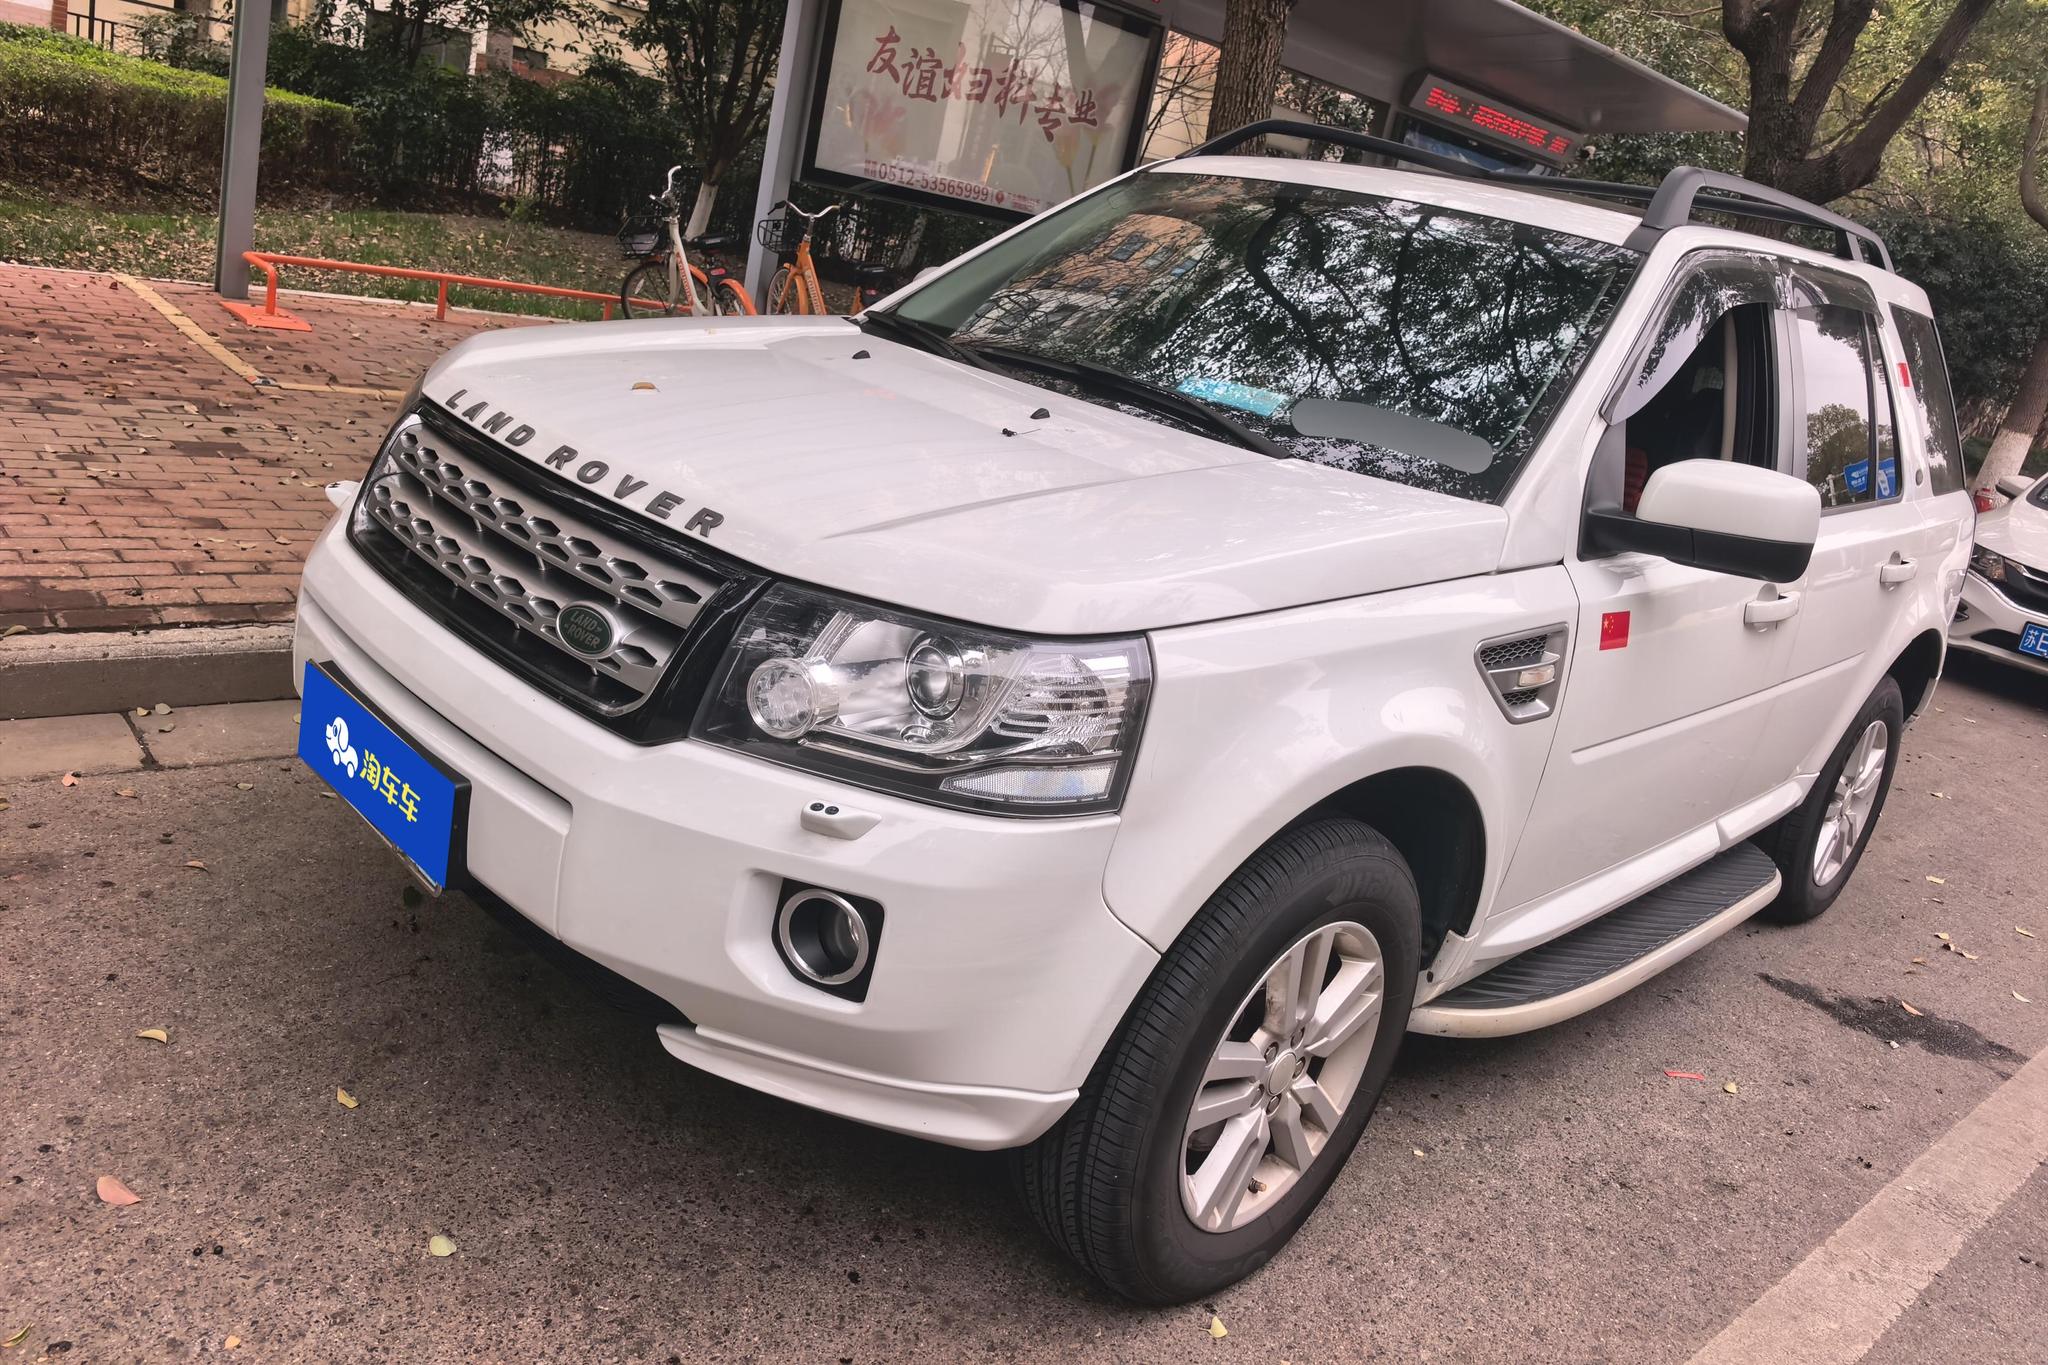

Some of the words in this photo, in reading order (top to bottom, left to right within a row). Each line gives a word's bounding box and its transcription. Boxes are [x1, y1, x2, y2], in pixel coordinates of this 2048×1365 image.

[866, 26, 1097, 142] 友谊妇科专业
[879, 163, 989, 202] 0512-53565999
[445, 389, 535, 446] LAND
[544, 445, 725, 537] ROVER
[567, 624, 600, 648] ROVER
